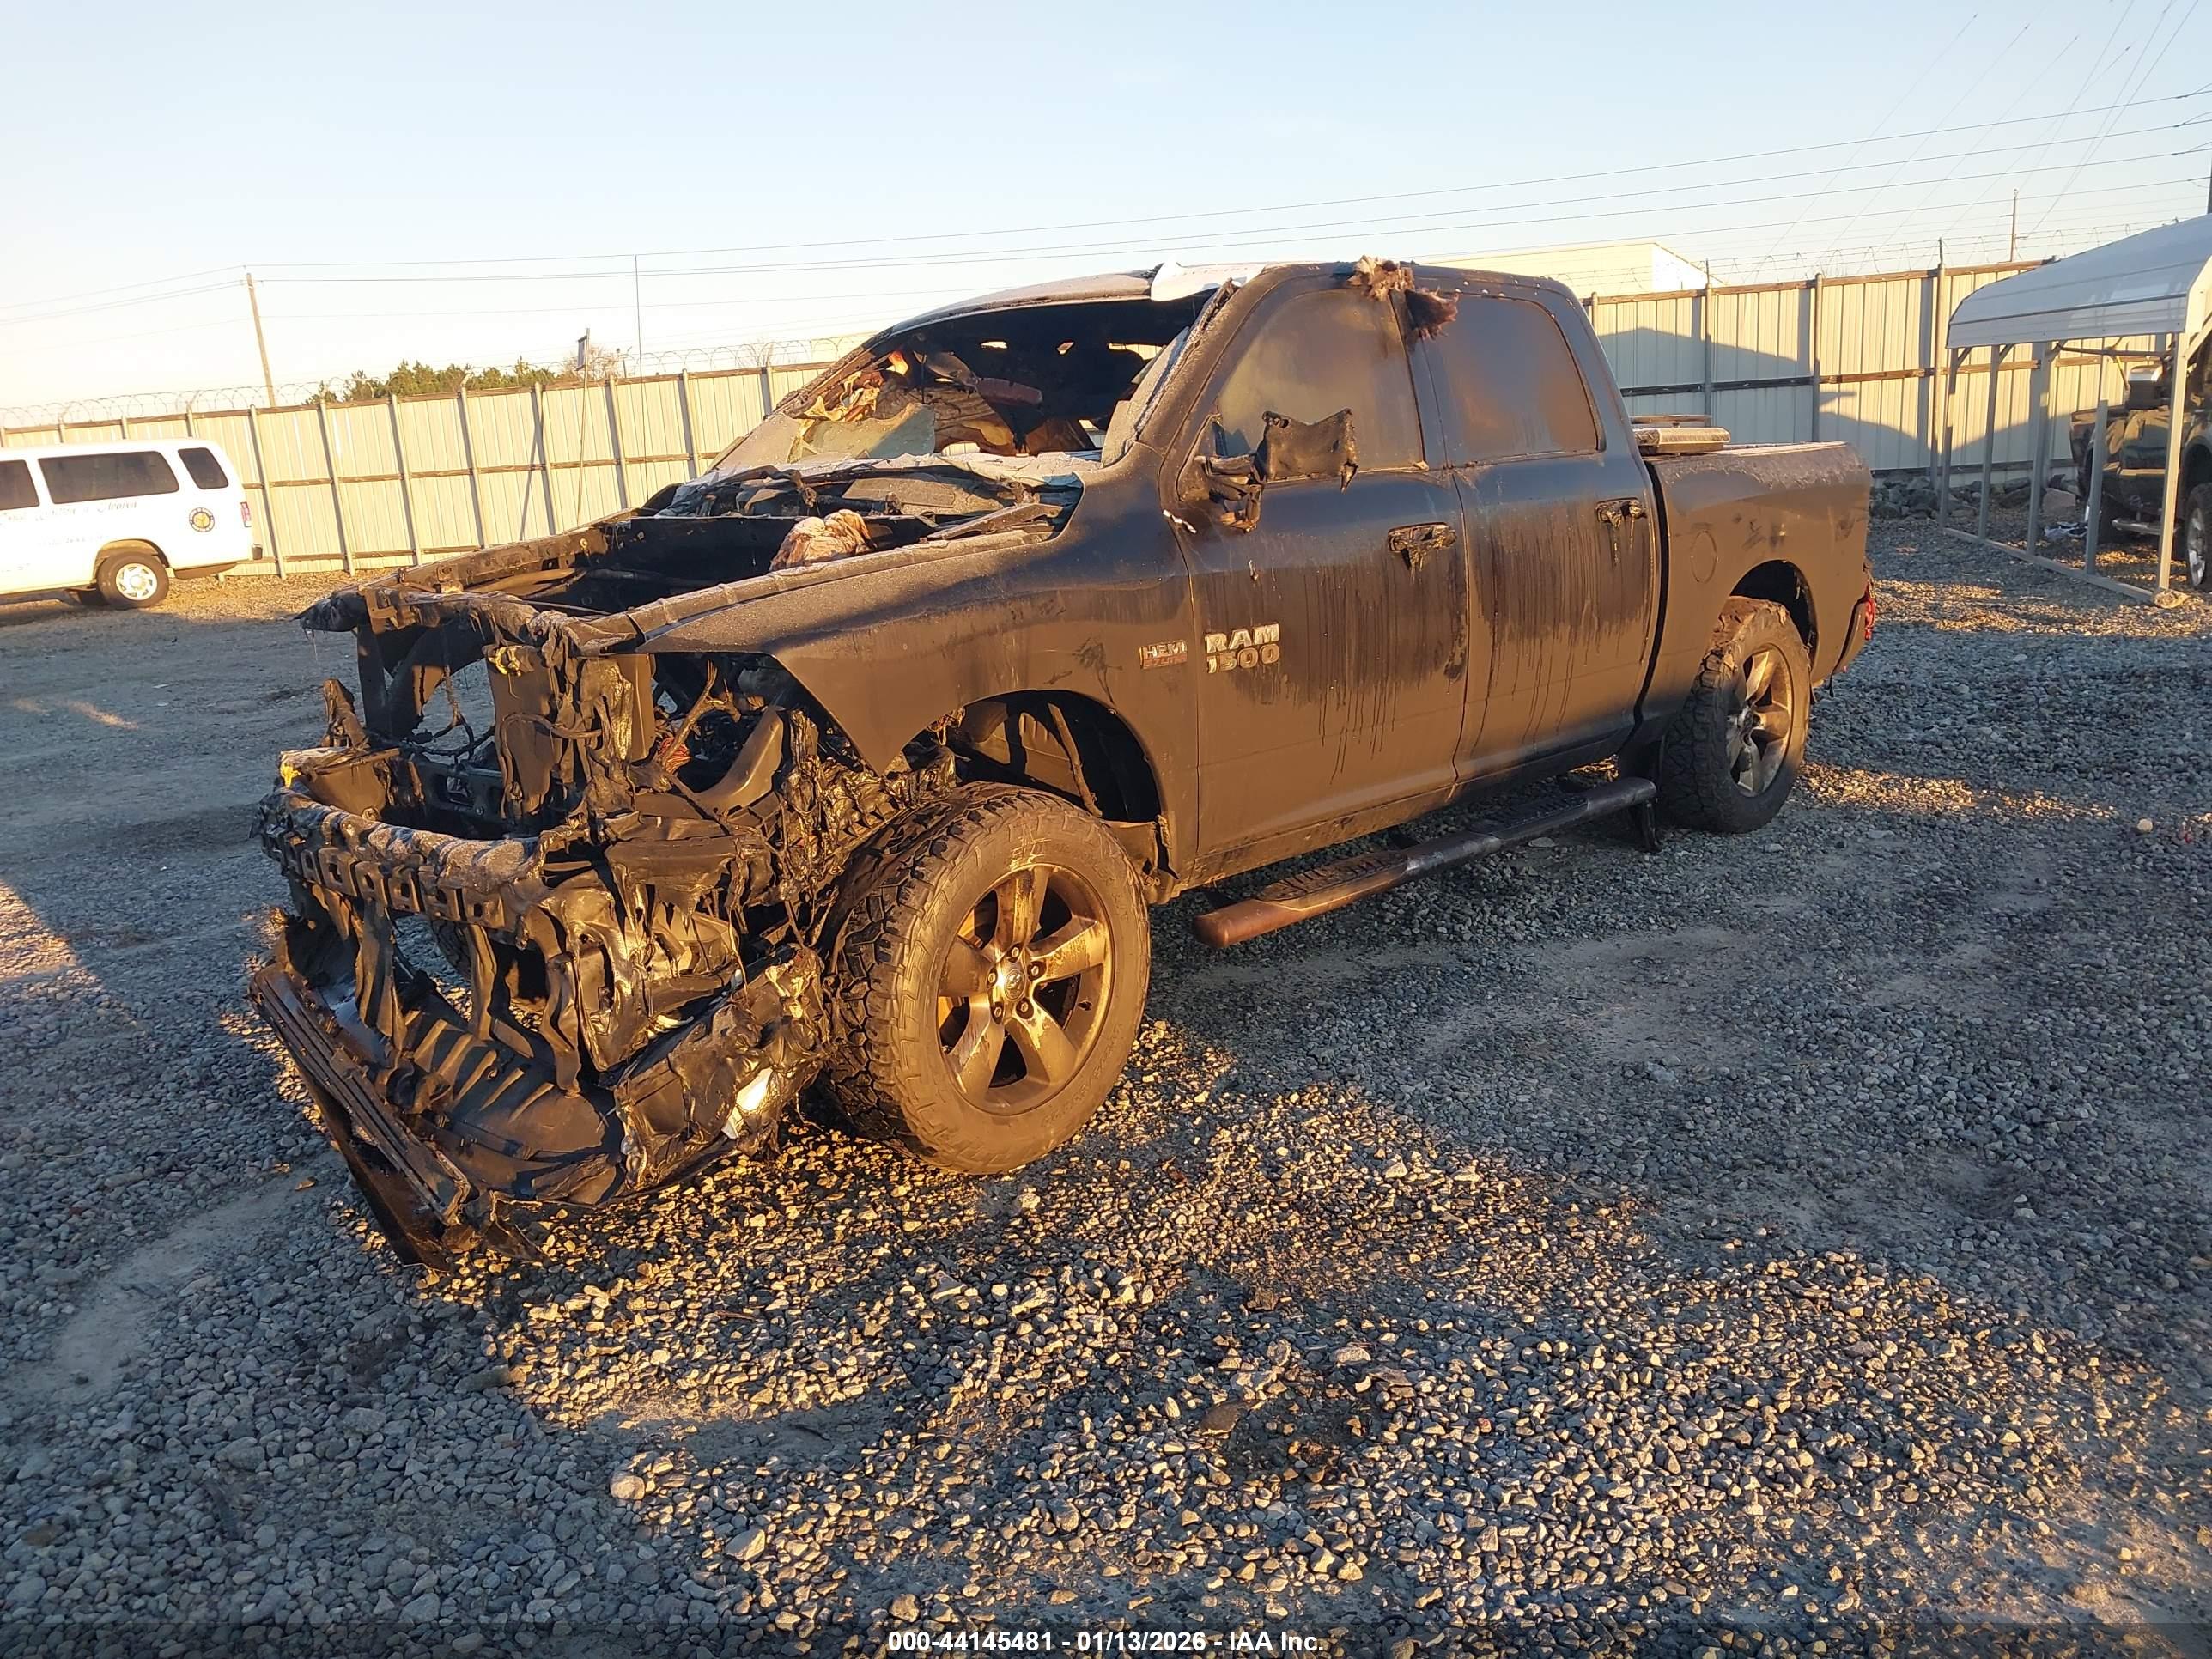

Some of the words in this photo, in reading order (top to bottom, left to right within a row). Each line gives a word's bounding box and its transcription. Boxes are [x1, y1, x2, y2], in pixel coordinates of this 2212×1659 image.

[1143, 641, 1188, 659] HEMI
[1206, 623, 1280, 653] RAM
[1206, 644, 1280, 673] 1500
